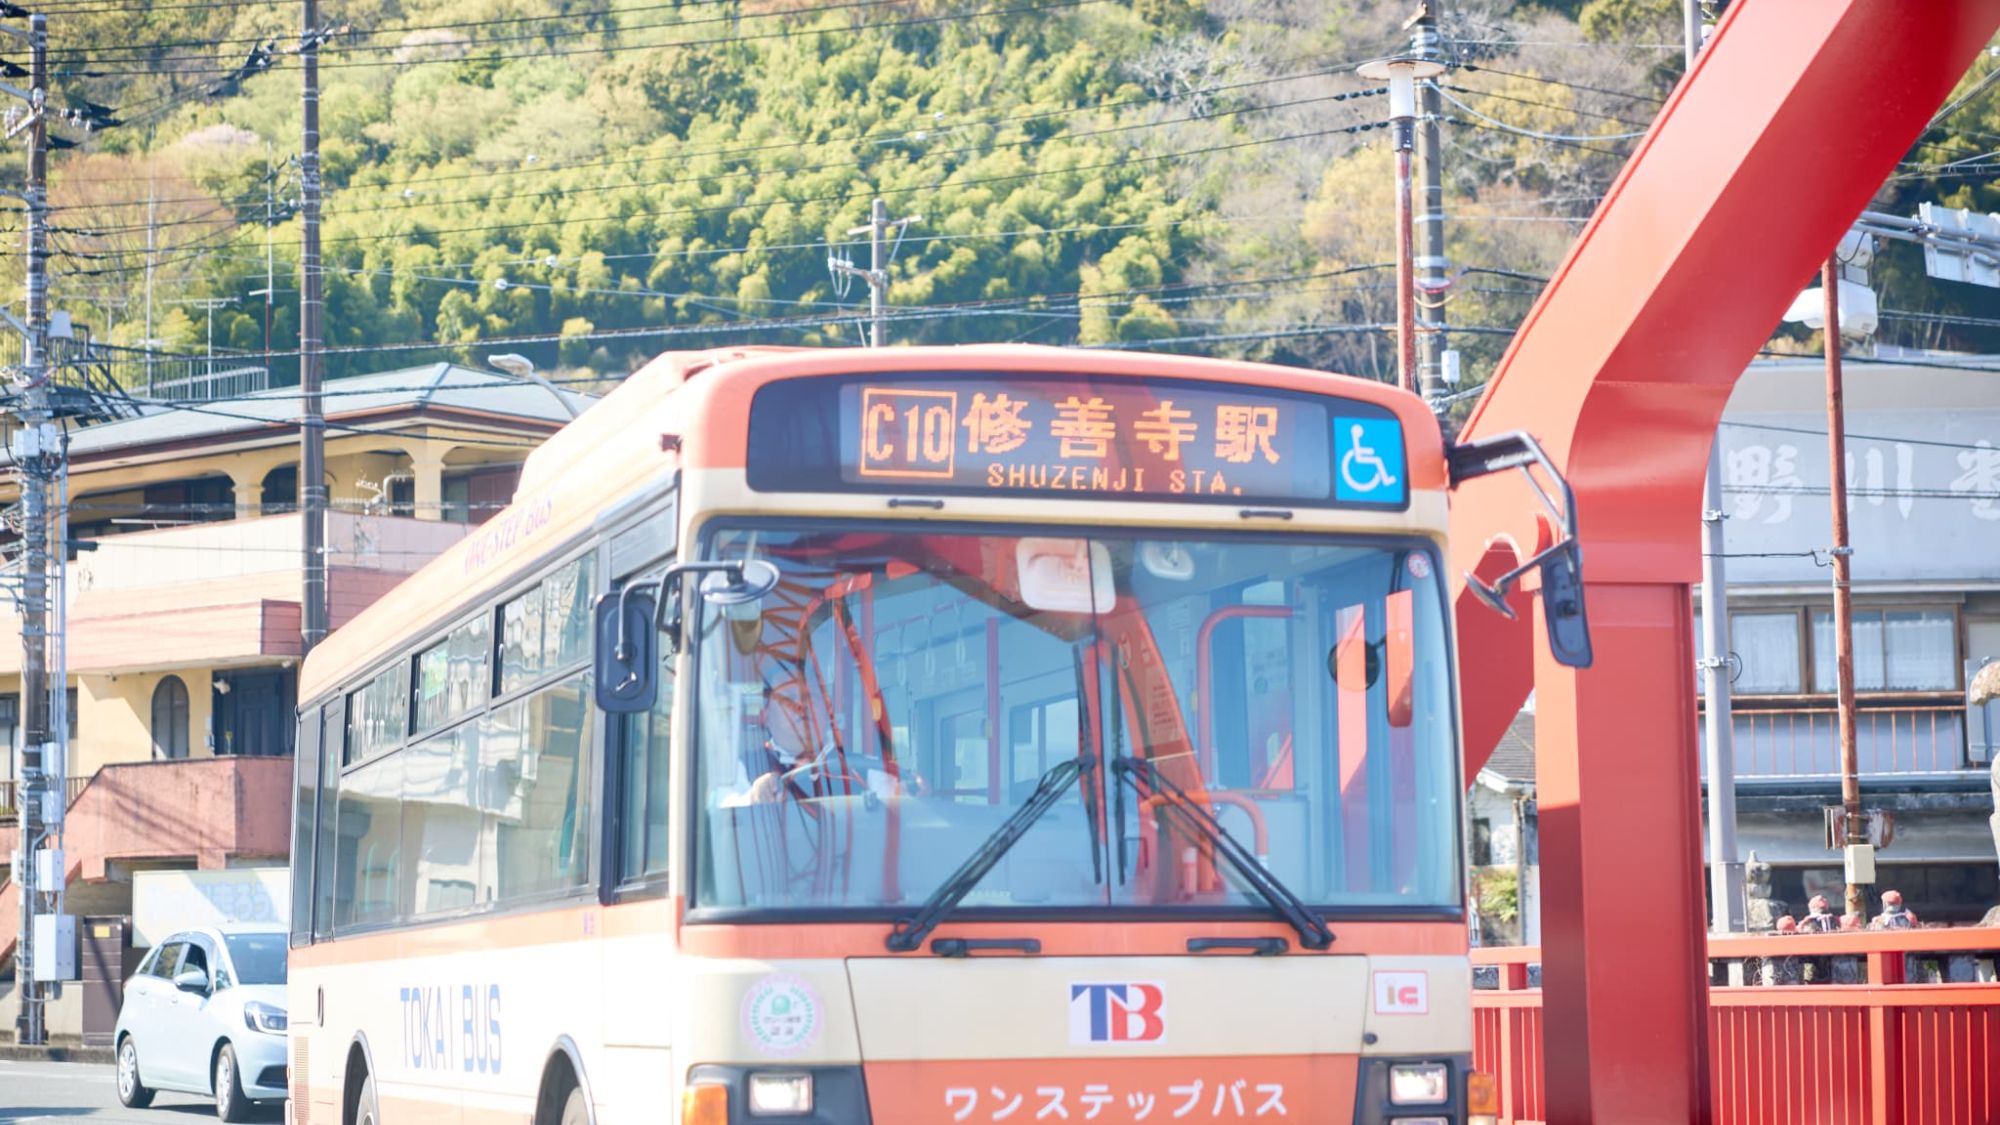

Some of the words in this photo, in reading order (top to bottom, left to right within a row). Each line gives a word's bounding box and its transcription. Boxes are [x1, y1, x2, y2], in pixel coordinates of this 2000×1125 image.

[867, 402, 951, 463] C10
[961, 392, 1280, 465] 修善寺駅
[987, 462, 1145, 493] SHUZENJI
[1169, 470, 1243, 496] STA.
[400, 985, 454, 1071] TOKAI
[462, 983, 502, 1075] BUS
[944, 1079, 1287, 1122] ワンステップバス
